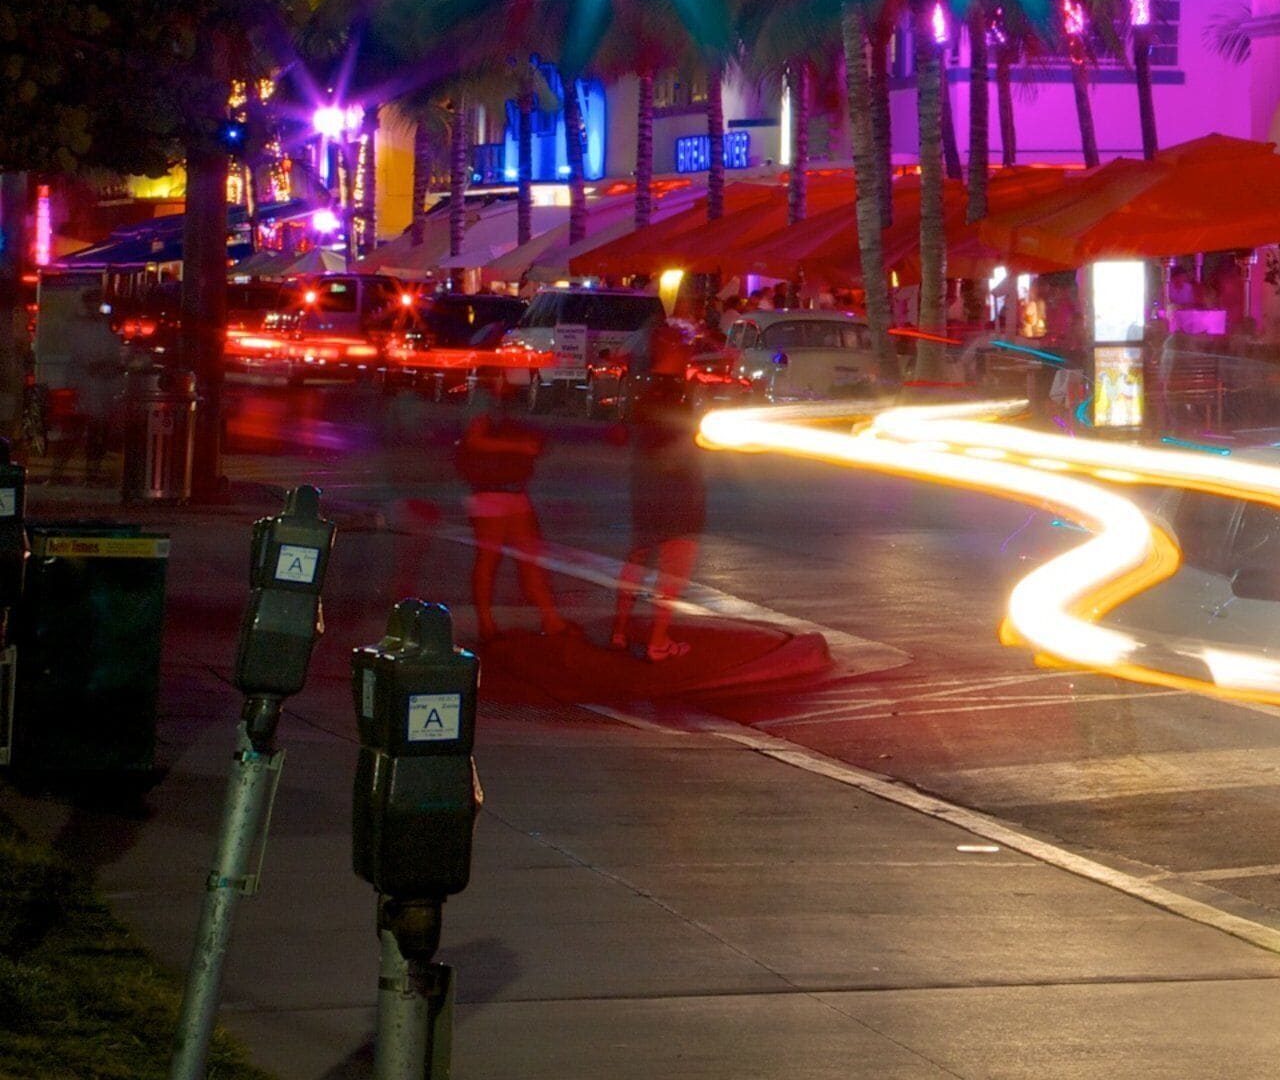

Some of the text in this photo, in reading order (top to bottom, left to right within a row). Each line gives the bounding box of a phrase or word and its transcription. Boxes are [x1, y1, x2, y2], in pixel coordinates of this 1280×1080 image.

[678, 133, 747, 173] BREAKATER
[287, 556, 303, 573] A
[423, 708, 443, 729] A
